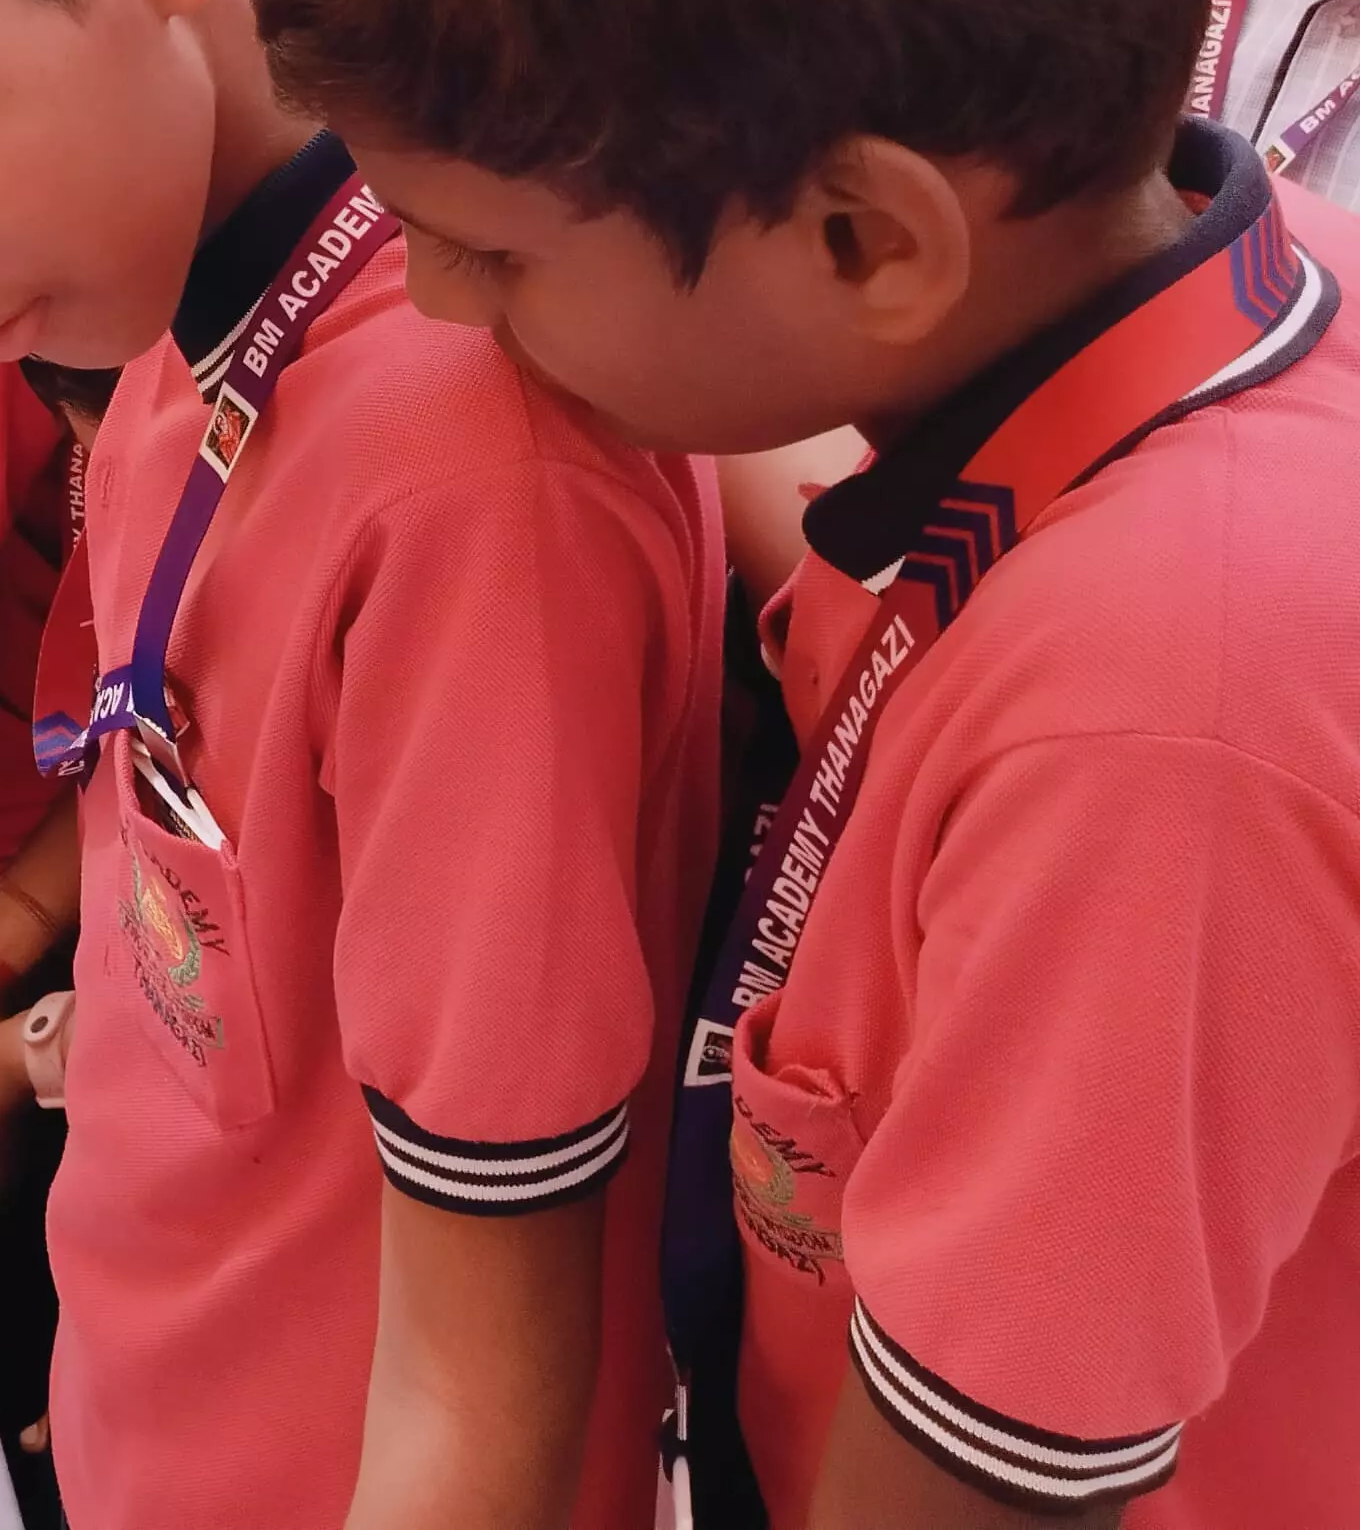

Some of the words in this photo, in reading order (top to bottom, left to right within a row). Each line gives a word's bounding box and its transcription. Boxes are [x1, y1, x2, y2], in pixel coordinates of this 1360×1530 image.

[1191, 0, 1232, 117] ANAGAZI
[1299, 99, 1337, 135] BM
[242, 317, 284, 378] BM
[277, 182, 386, 322] ACADEM
[809, 614, 916, 815] THANAGAZI
[750, 805, 832, 988] ACADEMY
[732, 967, 783, 1011] BM
